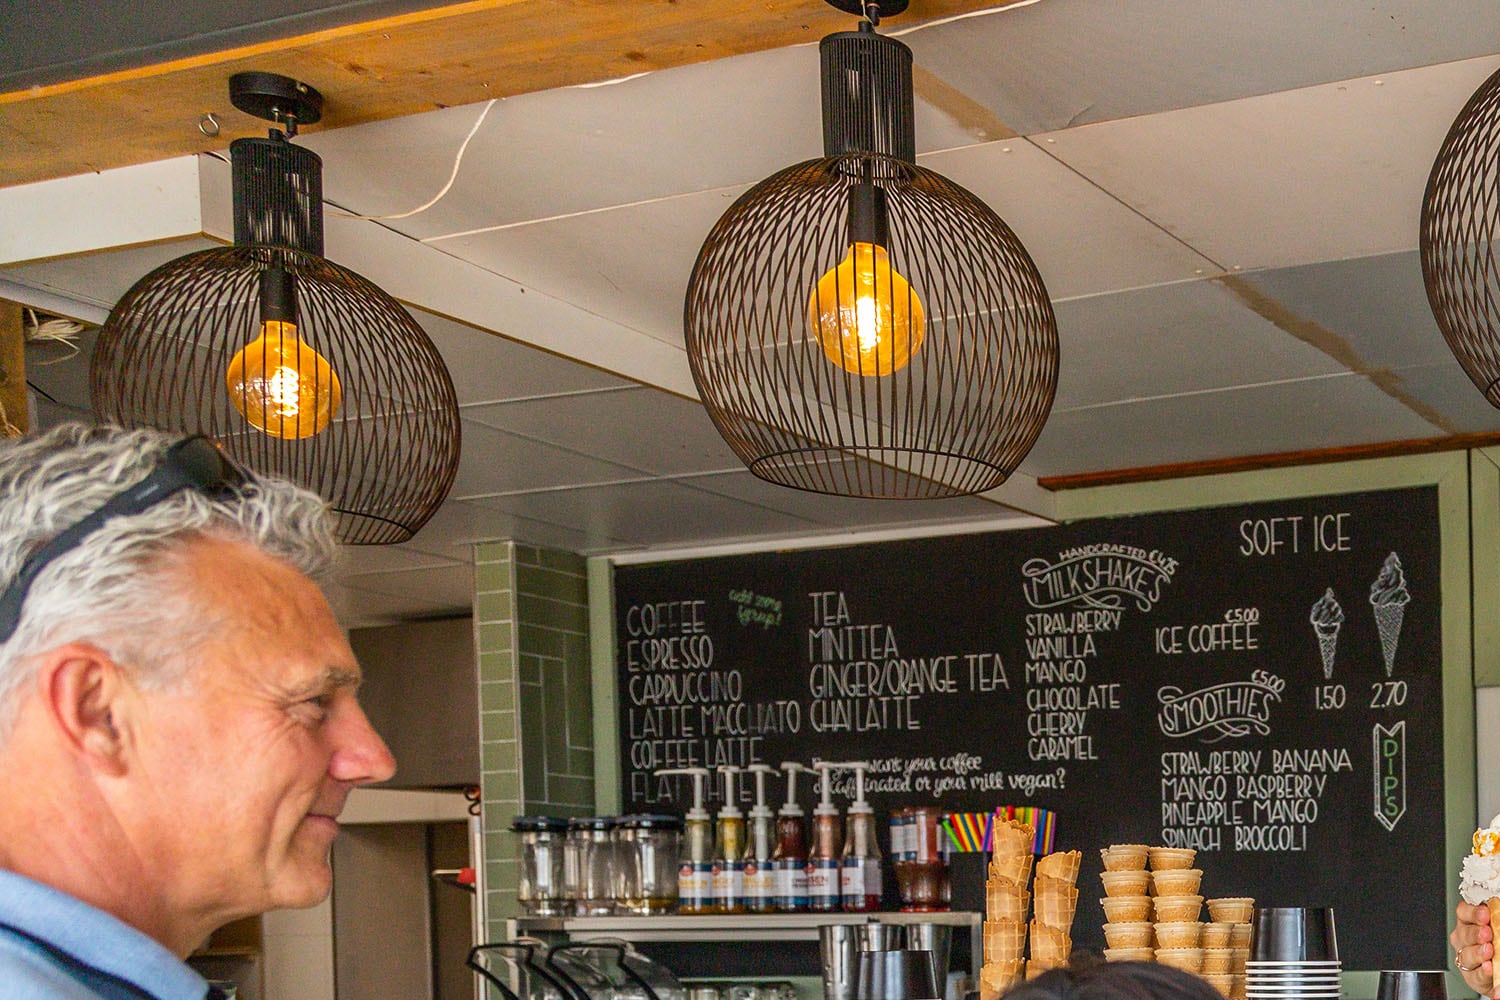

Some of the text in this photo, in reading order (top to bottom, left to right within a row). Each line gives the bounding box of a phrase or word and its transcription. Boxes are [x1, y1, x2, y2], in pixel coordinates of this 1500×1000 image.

[1239, 513, 1351, 556] SOFT ICE
[1031, 557, 1168, 603] MILKSHAKES
[627, 600, 706, 637] COFFEE
[808, 592, 851, 626] TEA
[1025, 610, 1122, 636] STRAWBERRY
[627, 635, 714, 672] ESPRESSO
[1025, 634, 1098, 660] VANILLA
[1155, 622, 1260, 655] ICE COFFEE
[809, 653, 1010, 698] GINGER/ORANGE TEA
[1025, 659, 1087, 683] MANGO
[628, 670, 743, 706] CAPPUCCINO
[1026, 684, 1121, 711] CHOCOLATE
[1315, 681, 1408, 709] 1.50 2.70
[629, 704, 694, 740] LATTE
[1027, 711, 1087, 737] CHERRY
[1163, 687, 1275, 733] SMOOTHIES
[630, 736, 764, 770] COFFEE LATTE
[1027, 735, 1099, 761] CARAMEL
[1161, 748, 1354, 776] STRAWBERRY BANANA
[939, 752, 983, 776] coffee
[1383, 738, 1399, 817] DIPS
[1007, 767, 1066, 797] vegan?
[1161, 774, 1328, 801] MANGO RASPBERRY
[1161, 798, 1318, 827] PINEAPPLE MANGO
[1161, 825, 1307, 851] SPINACH BROCCOLI
